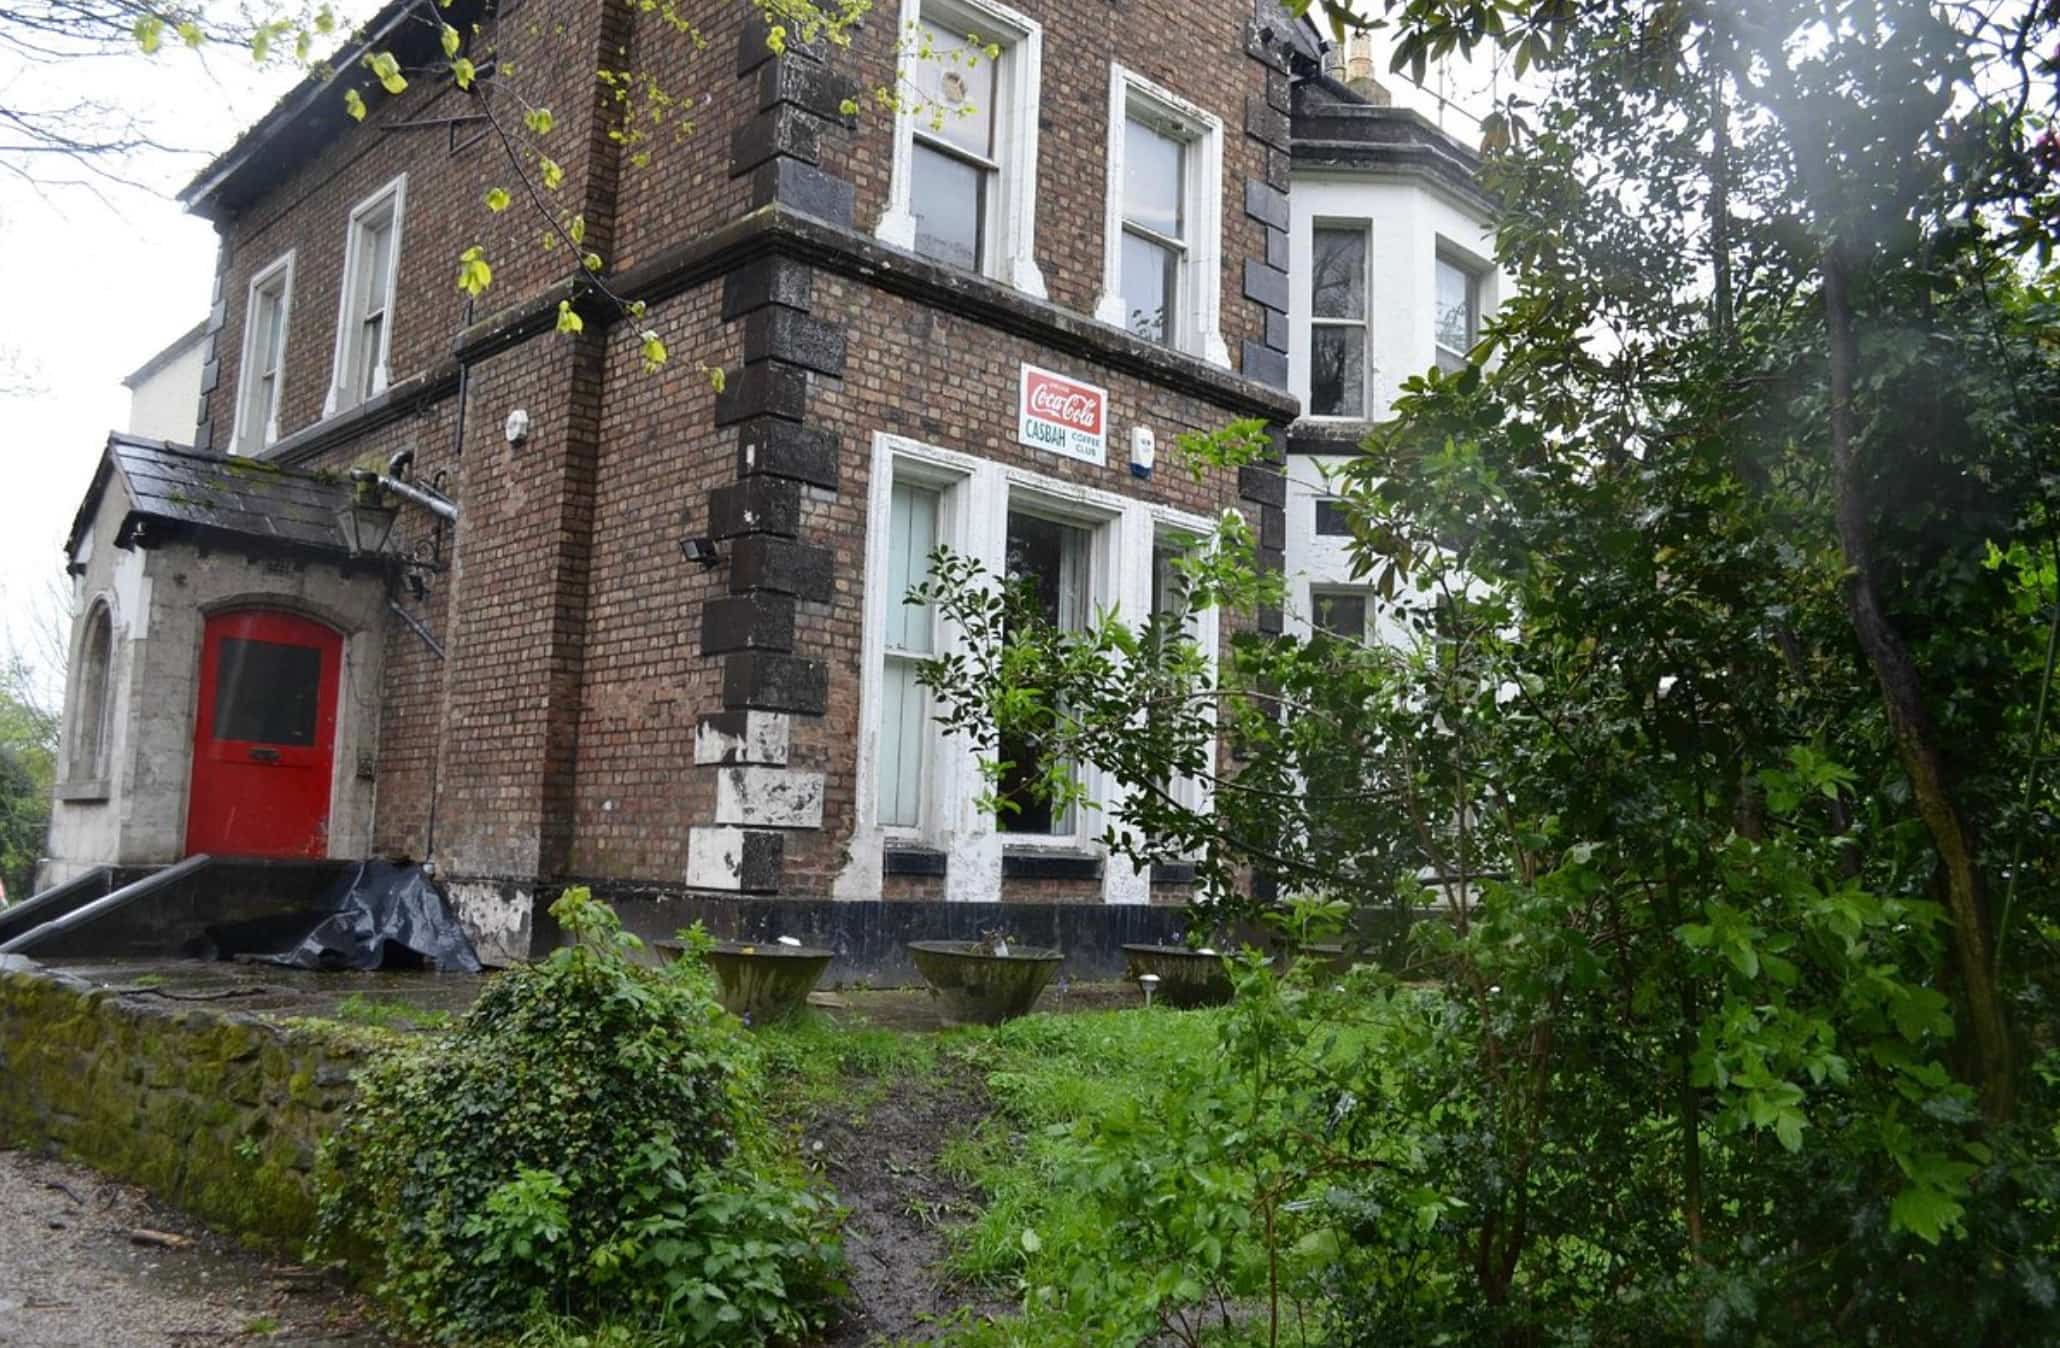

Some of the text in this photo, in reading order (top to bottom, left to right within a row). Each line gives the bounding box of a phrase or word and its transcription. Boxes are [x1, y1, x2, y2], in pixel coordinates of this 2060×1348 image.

[1025, 418, 1066, 448] CASBAH
[1071, 431, 1100, 447] COFFEE
[1075, 443, 1097, 457] CLUB
